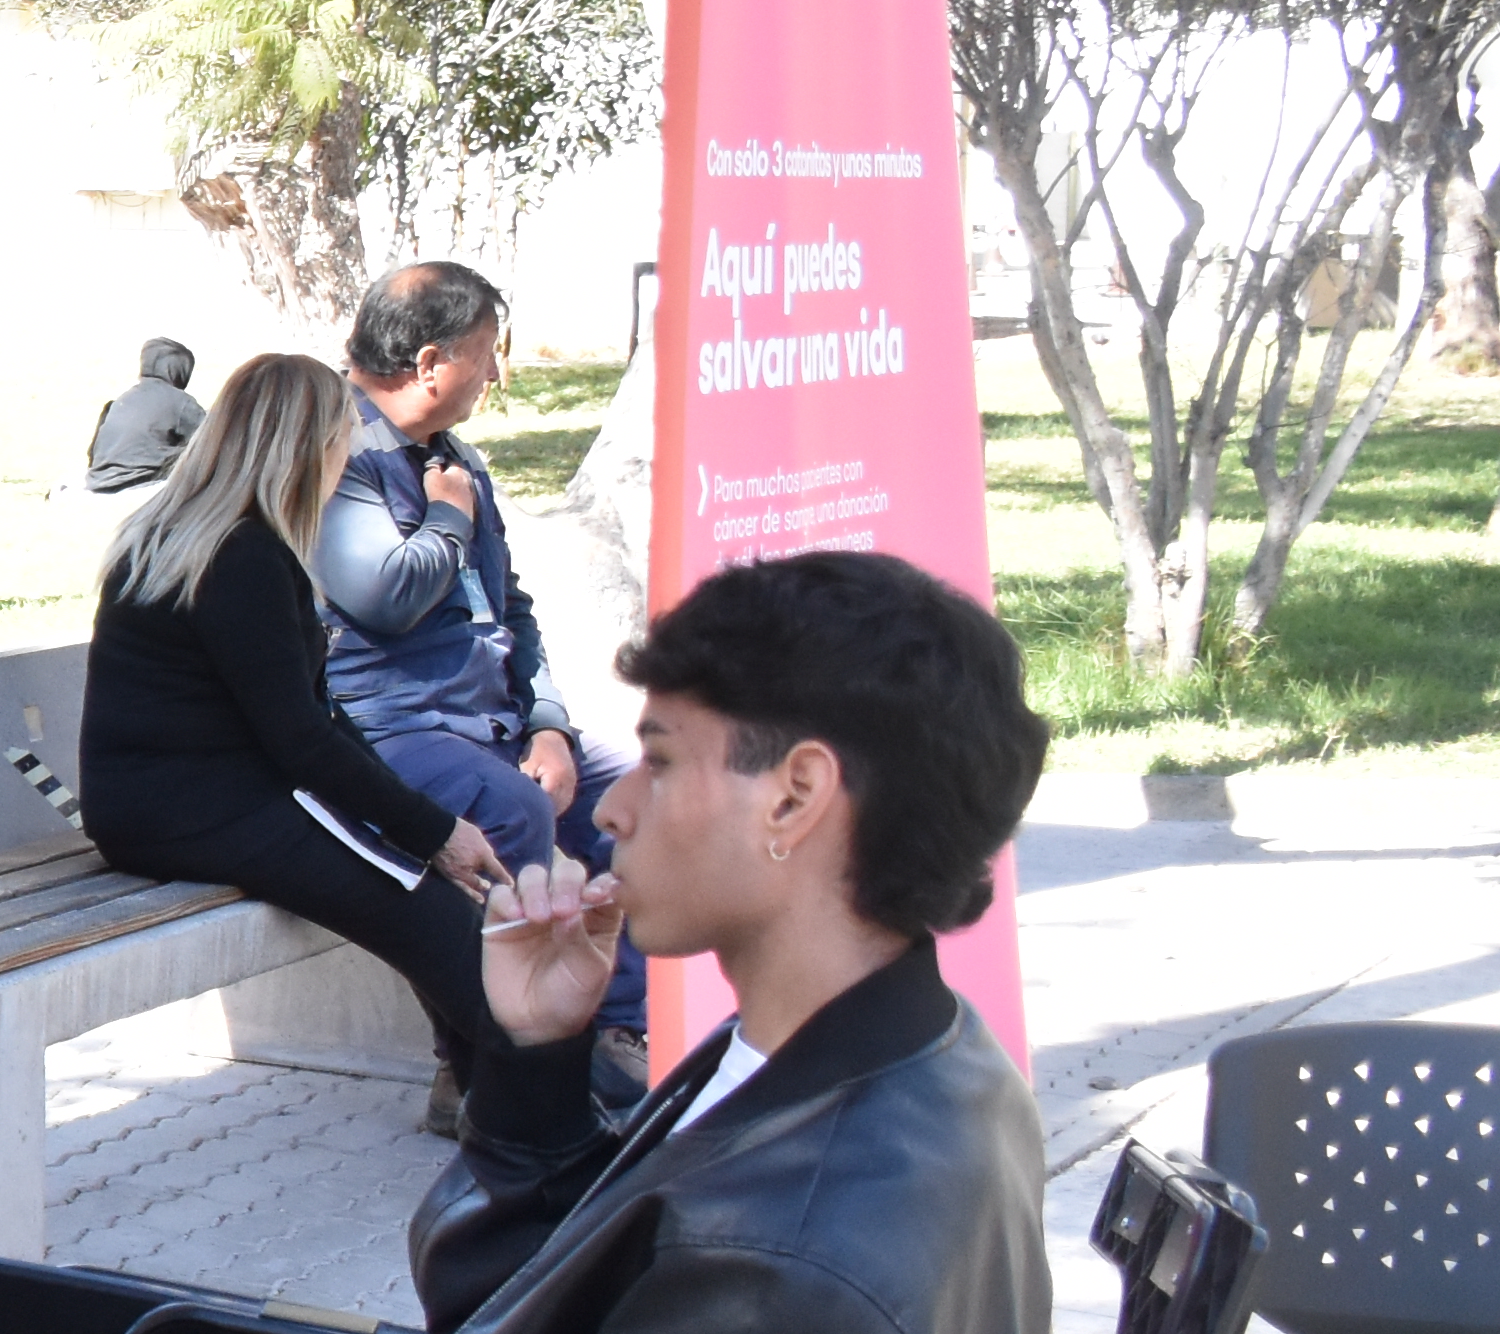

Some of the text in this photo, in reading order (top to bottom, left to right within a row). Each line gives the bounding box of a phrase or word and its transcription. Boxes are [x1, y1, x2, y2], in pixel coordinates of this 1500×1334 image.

[706, 139, 732, 177] Con
[734, 138, 769, 177] sólo
[772, 140, 783, 177] 3
[833, 153, 841, 188] y
[841, 153, 872, 178] unos
[874, 142, 922, 178] minutos
[700, 222, 862, 319] Aquí puedes
[697, 306, 904, 395] salvar una vida
[713, 475, 743, 503] Para
[746, 466, 800, 498] muchos
[843, 460, 863, 482] con
[713, 512, 759, 542] cáncer
[761, 505, 780, 534] de
[837, 486, 889, 519] donación
